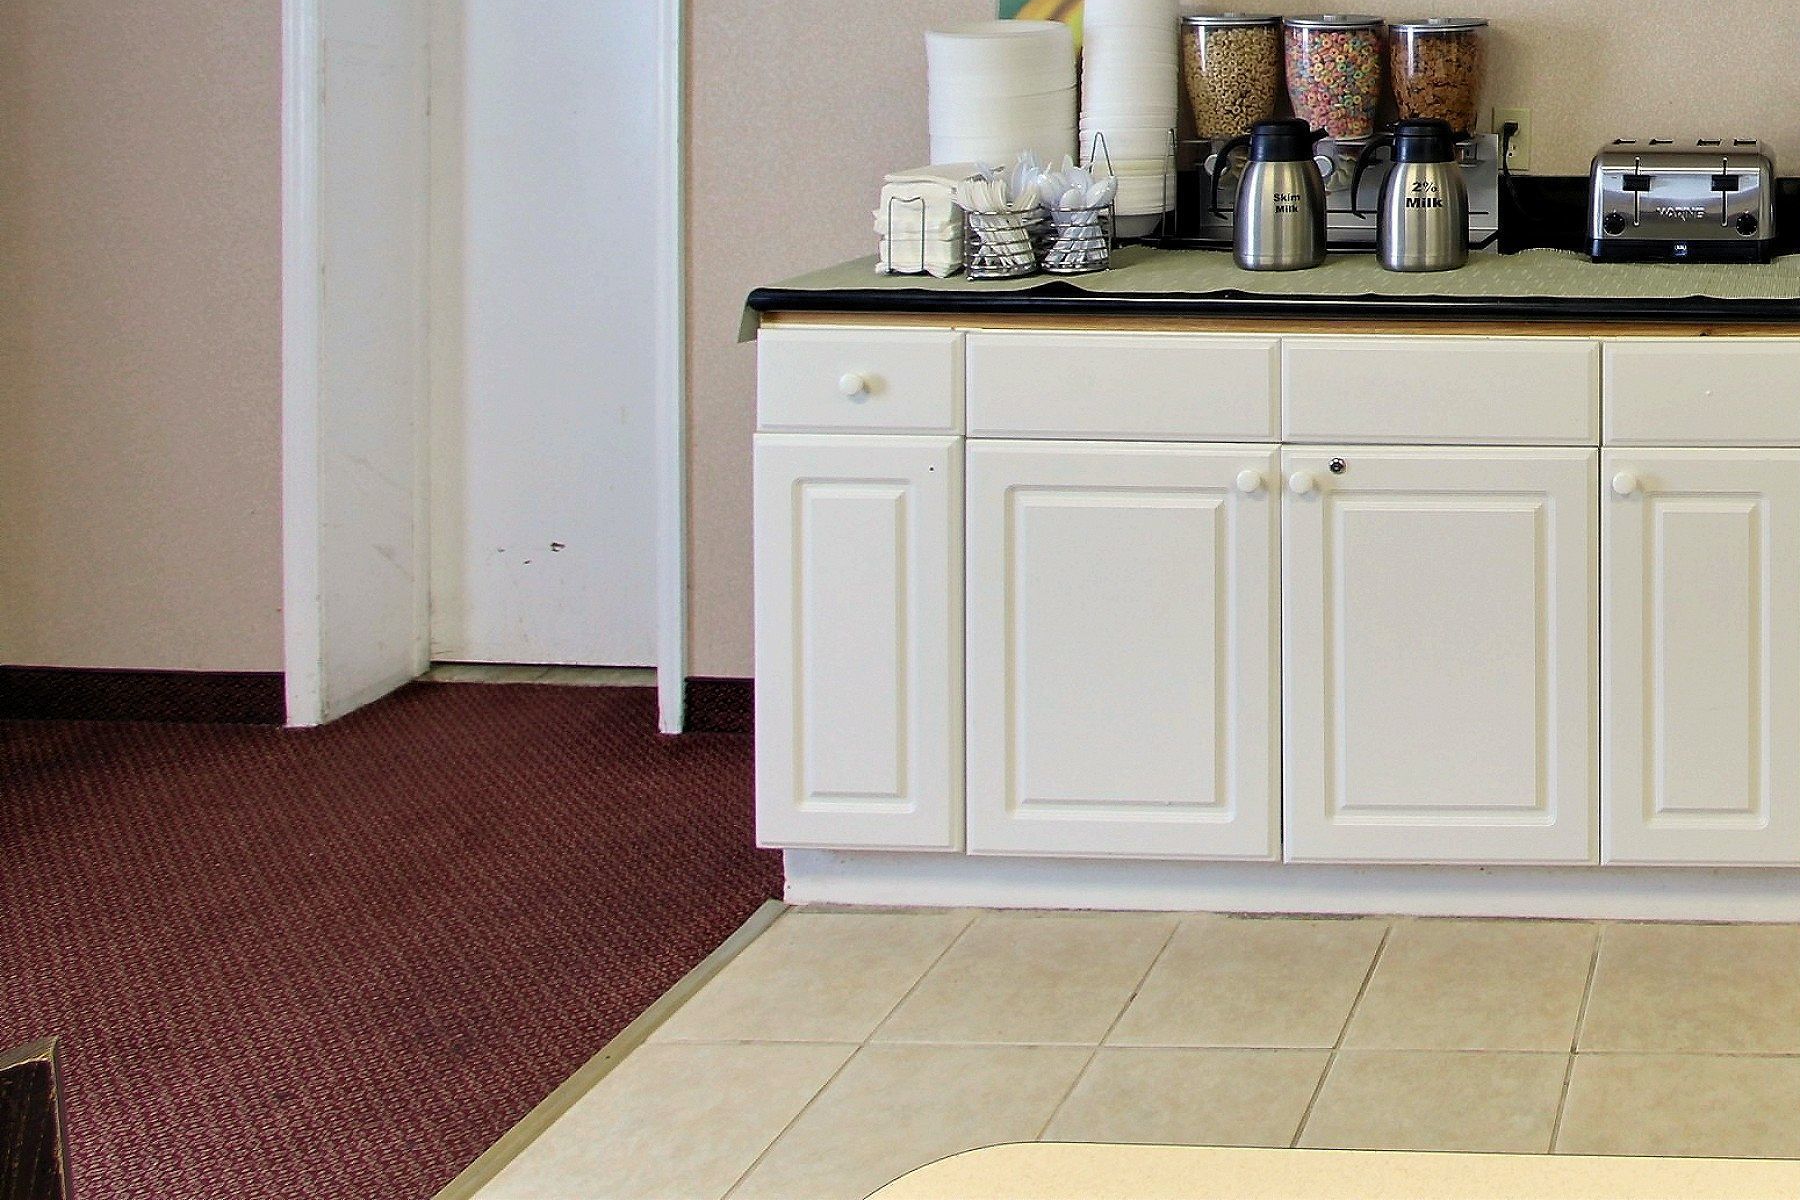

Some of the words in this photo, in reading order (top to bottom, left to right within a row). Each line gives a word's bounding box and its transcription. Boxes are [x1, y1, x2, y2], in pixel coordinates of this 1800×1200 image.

[1411, 181, 1439, 193] 2%
[1273, 192, 1301, 202] Skim
[1405, 197, 1443, 208] Milk
[1275, 204, 1299, 213] Milk
